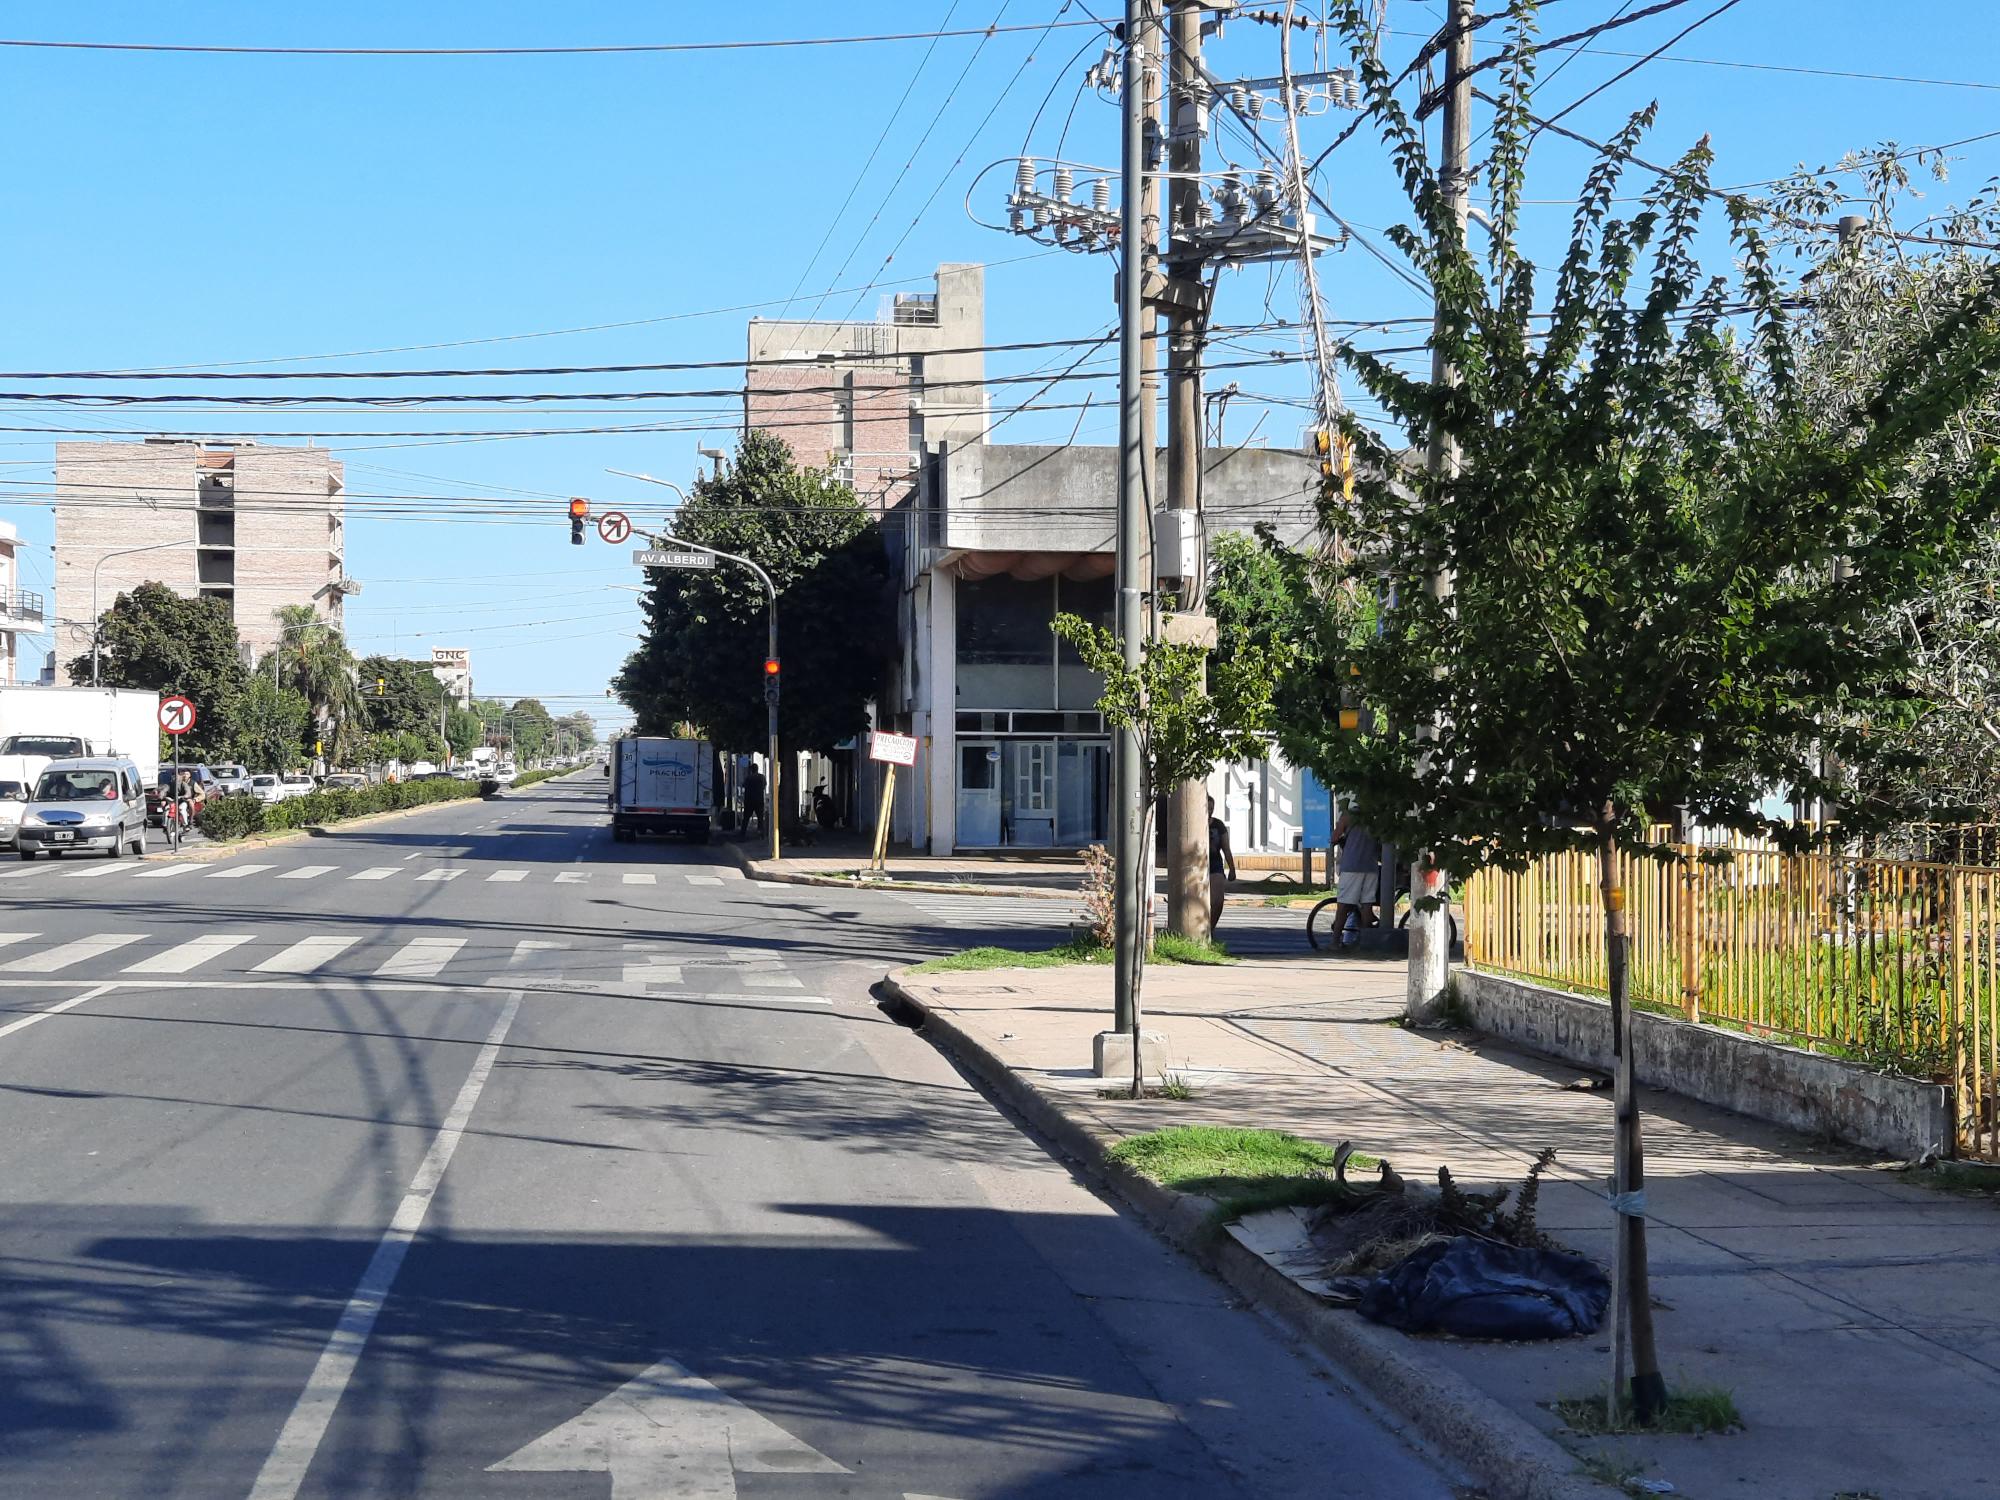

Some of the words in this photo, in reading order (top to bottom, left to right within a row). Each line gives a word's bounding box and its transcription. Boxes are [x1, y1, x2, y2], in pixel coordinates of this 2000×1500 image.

[640, 554, 657, 563] AV.
[659, 555, 709, 565] ALBERDI
[435, 650, 465, 660] GNC
